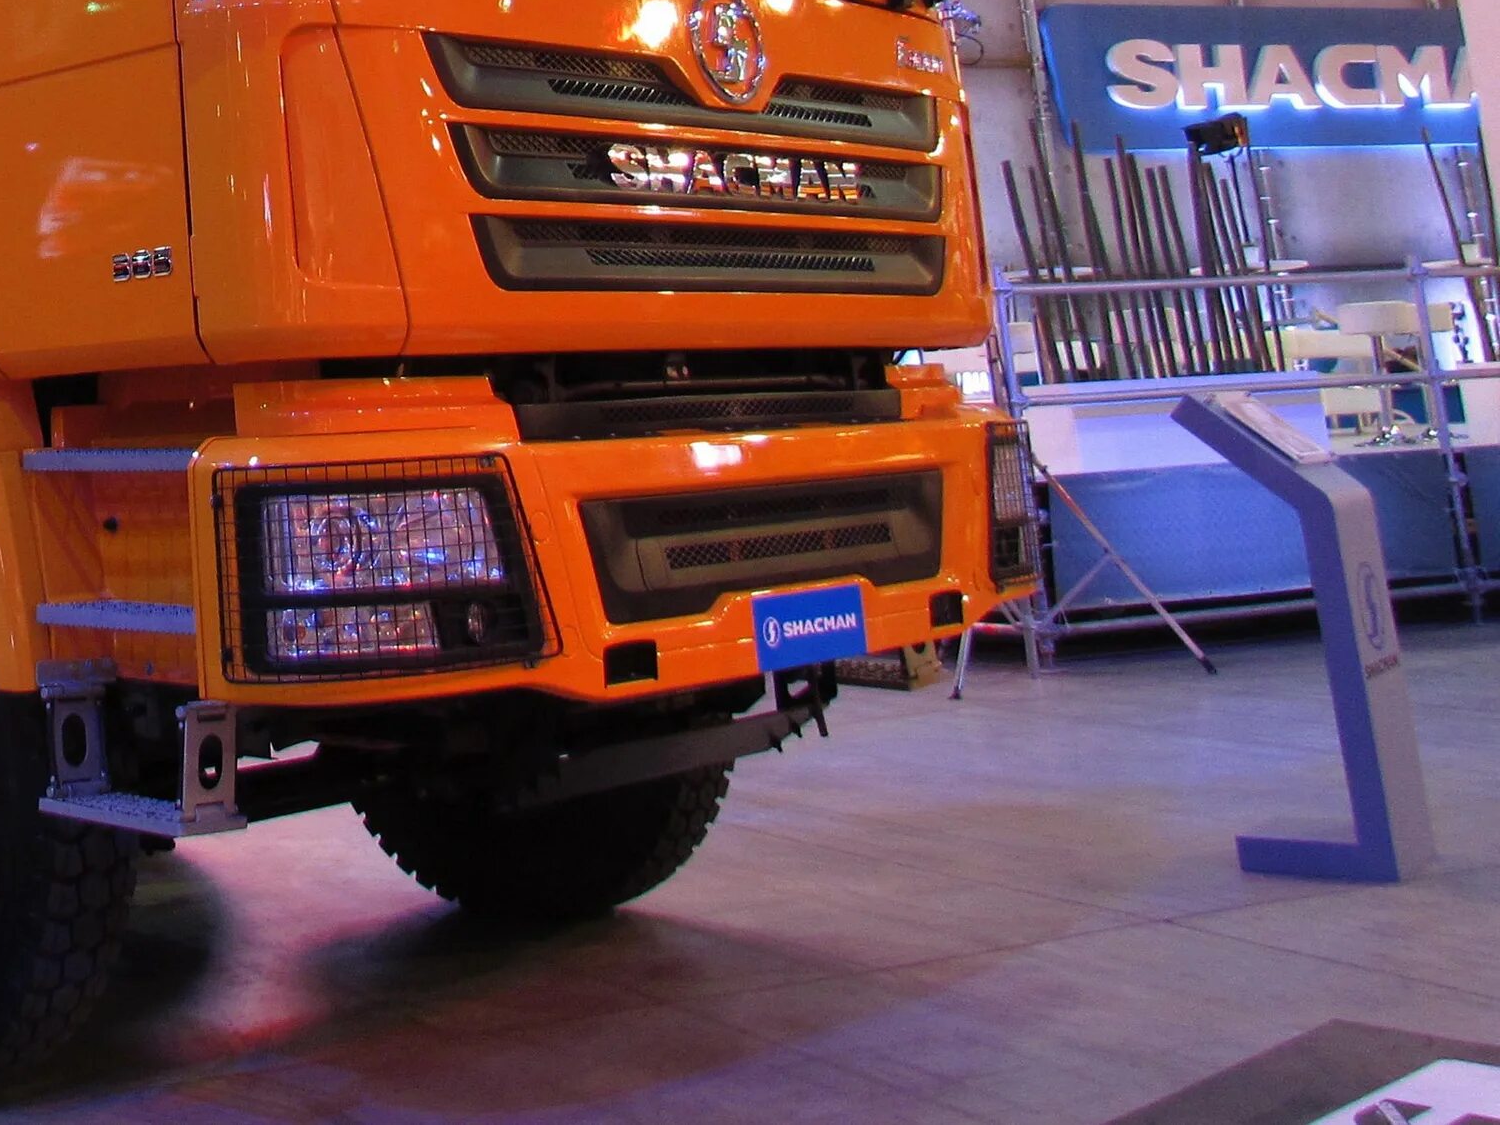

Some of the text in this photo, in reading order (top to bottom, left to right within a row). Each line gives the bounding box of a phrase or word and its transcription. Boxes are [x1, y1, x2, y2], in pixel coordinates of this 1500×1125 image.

[1104, 38, 1478, 111] SHACM
[608, 143, 858, 204] SHACMAN
[782, 613, 856, 637] SHACMAN
